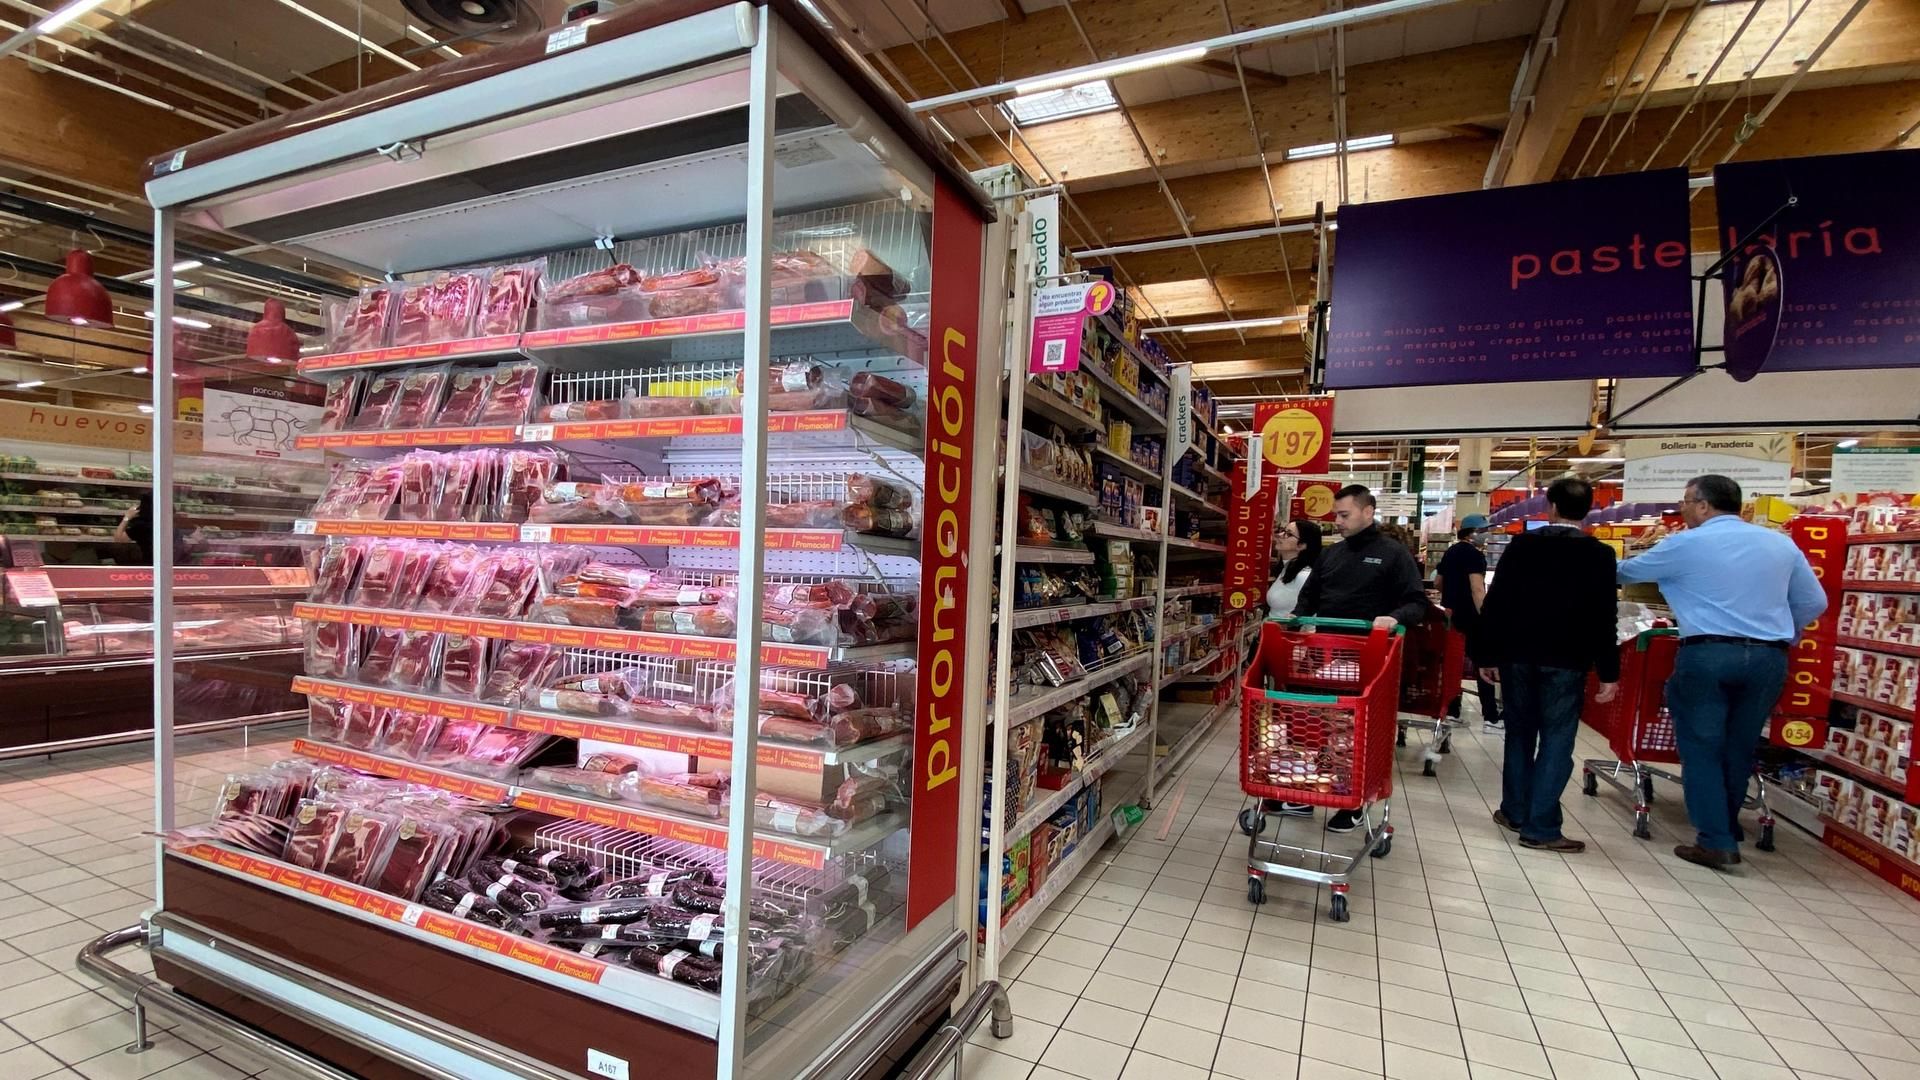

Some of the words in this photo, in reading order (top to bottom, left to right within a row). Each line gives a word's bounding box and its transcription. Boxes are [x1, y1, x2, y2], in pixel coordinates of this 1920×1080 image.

[1511, 233, 1687, 290] paste
[253, 386, 285, 398] porcino
[1176, 396, 1186, 443] crackers
[1259, 400, 1328, 412] promoción
[29, 407, 146, 436] huevos
[1268, 430, 1317, 456] 1'97
[926, 325, 966, 791] promoción
[1791, 526, 1828, 707] prooción
[558, 962, 592, 981] Promoción
[598, 1062, 616, 1075] A167
